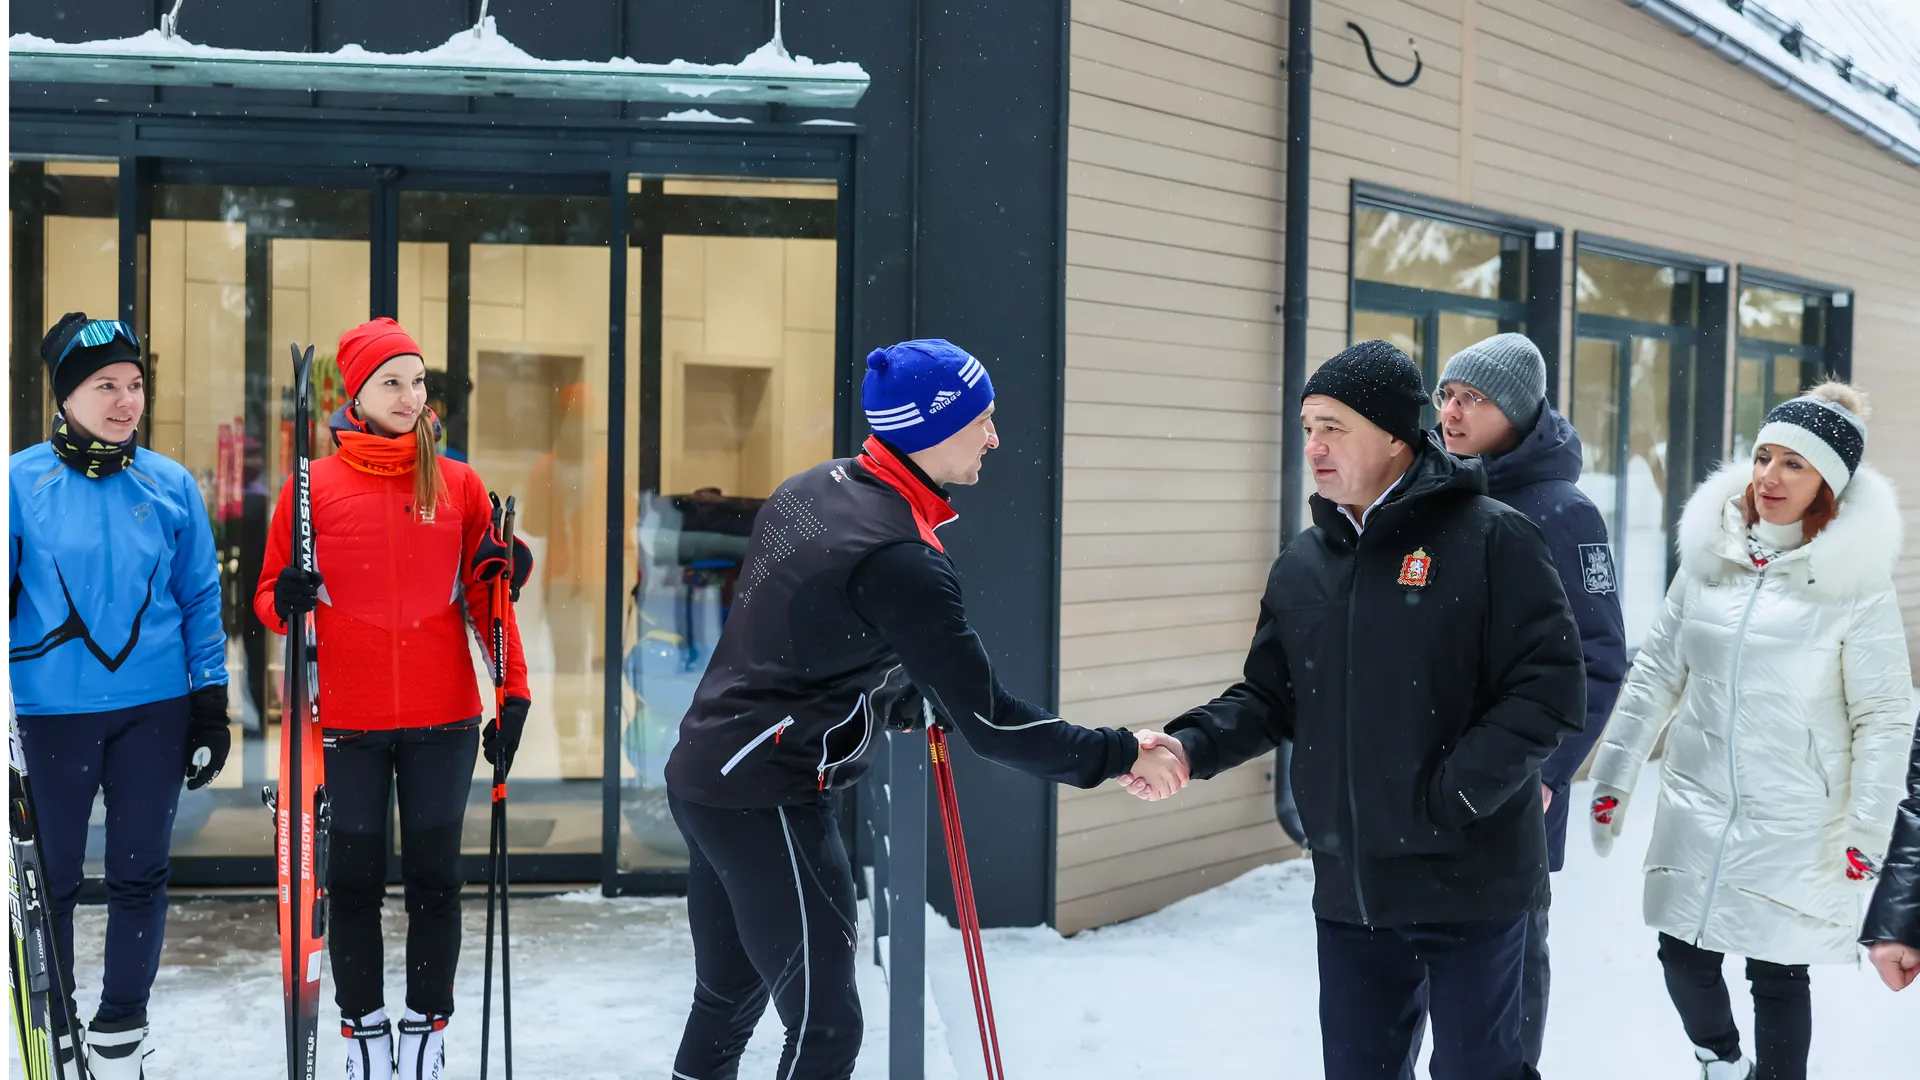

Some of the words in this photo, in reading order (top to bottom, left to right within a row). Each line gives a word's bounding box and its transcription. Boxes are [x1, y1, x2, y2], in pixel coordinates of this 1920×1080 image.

[929, 390, 962, 414] adidas
[300, 456, 312, 572] MADSHUS
[280, 809, 289, 876] MADSHUS
[301, 812, 311, 880] MADSHUS
[353, 1028, 384, 1036] MADSHUS
